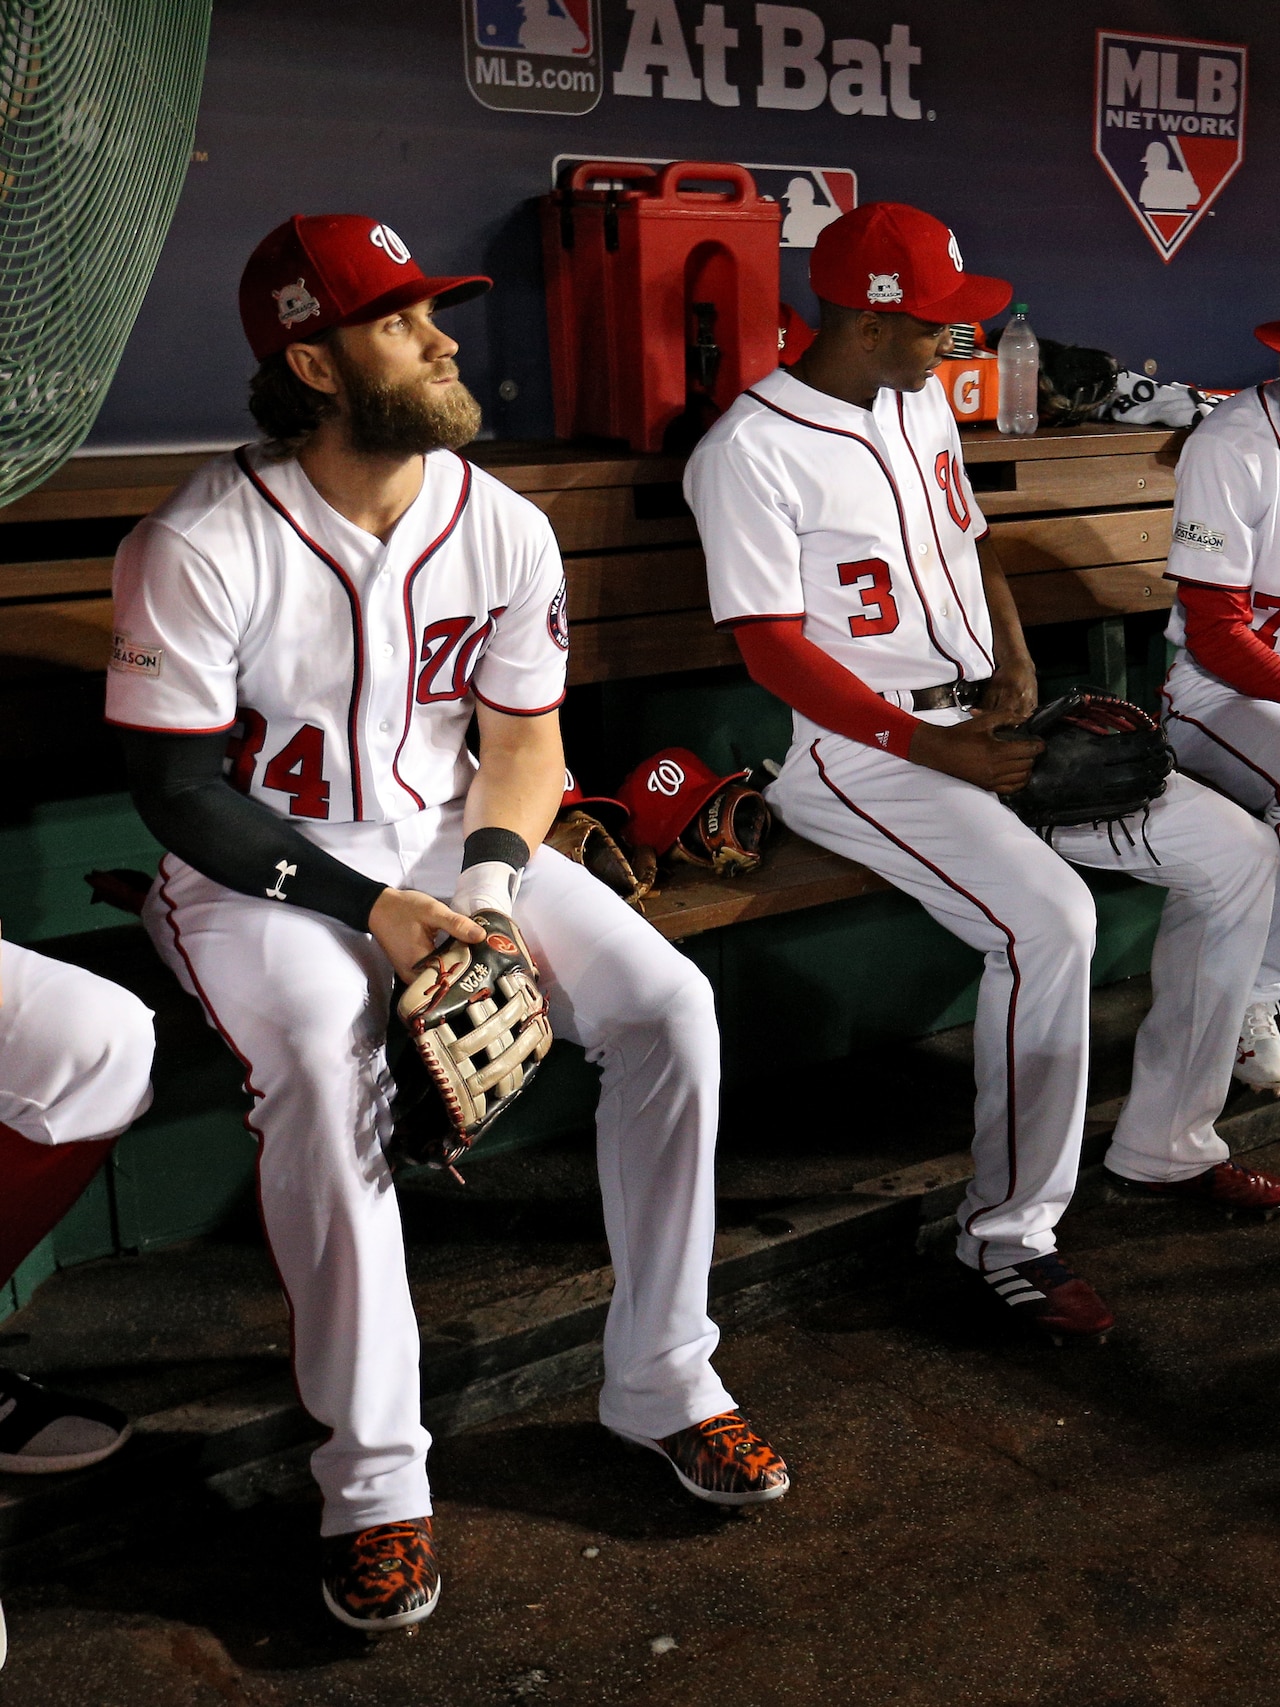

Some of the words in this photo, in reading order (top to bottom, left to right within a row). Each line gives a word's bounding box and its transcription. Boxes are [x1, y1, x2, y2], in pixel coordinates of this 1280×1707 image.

[475, 56, 595, 92] MLB.com
[613, 0, 740, 107] At
[756, 3, 923, 120] Bat
[1106, 46, 1239, 115] MLB
[1105, 109, 1236, 136] NETWORK
[954, 369, 981, 414] G
[837, 557, 900, 638] 3
[647, 759, 685, 797] W
